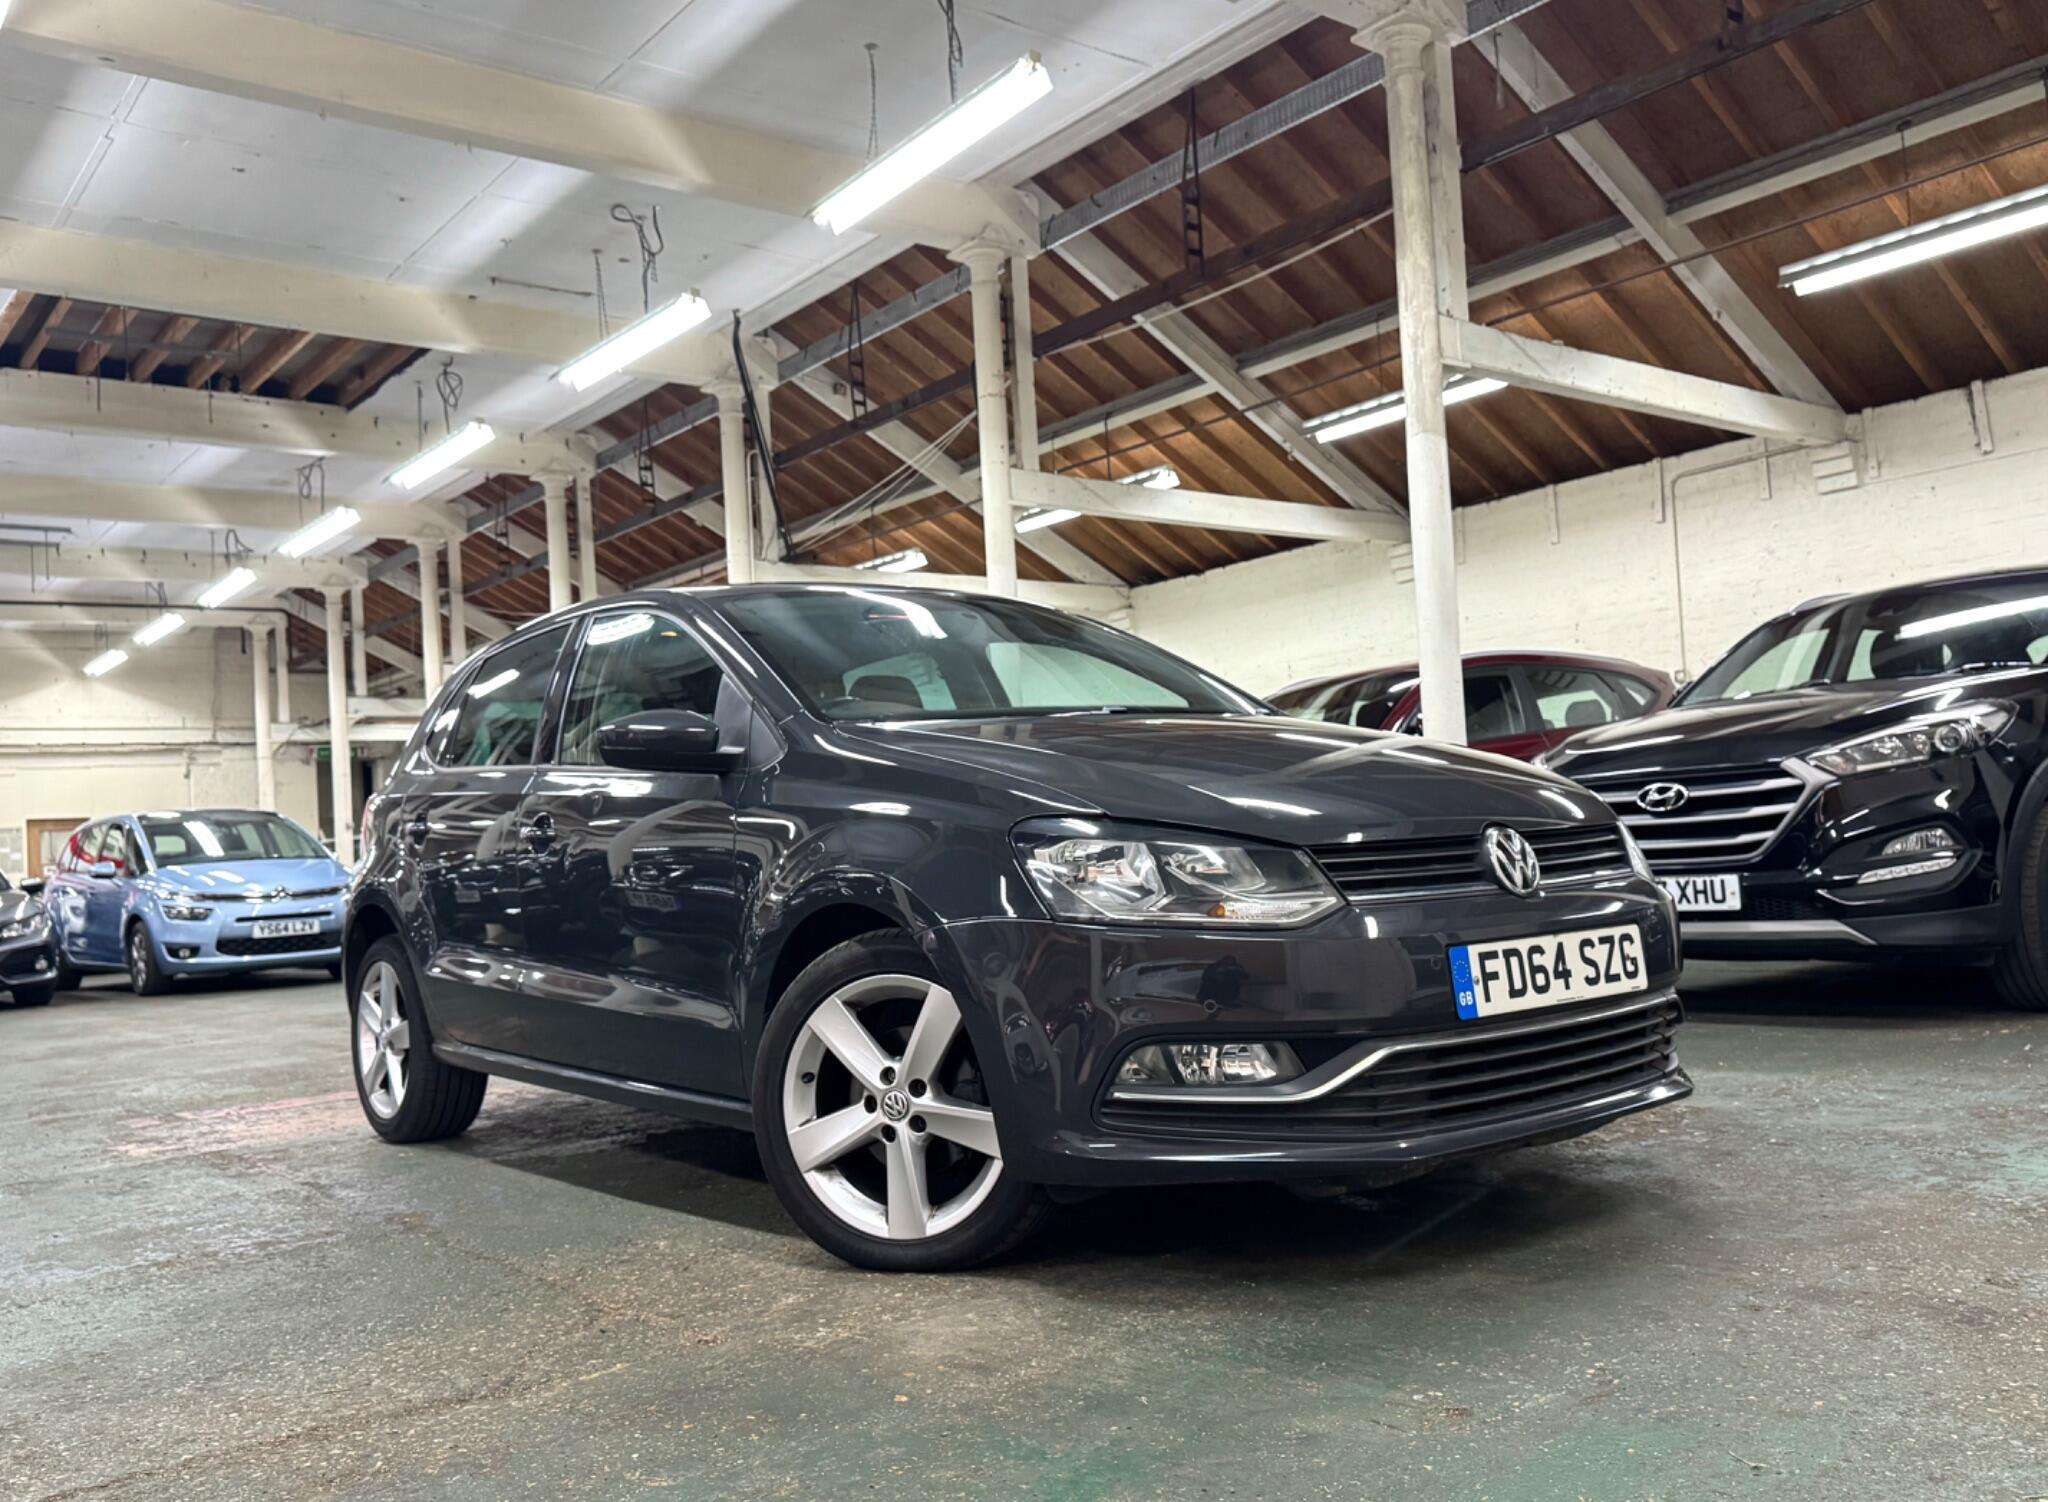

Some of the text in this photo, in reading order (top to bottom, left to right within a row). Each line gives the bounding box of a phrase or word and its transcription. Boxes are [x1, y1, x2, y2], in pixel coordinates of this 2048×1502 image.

[1674, 879, 1726, 904] XHU
[1478, 933, 1640, 1003] FD64 SZG
[1459, 990, 1473, 1006] GB
